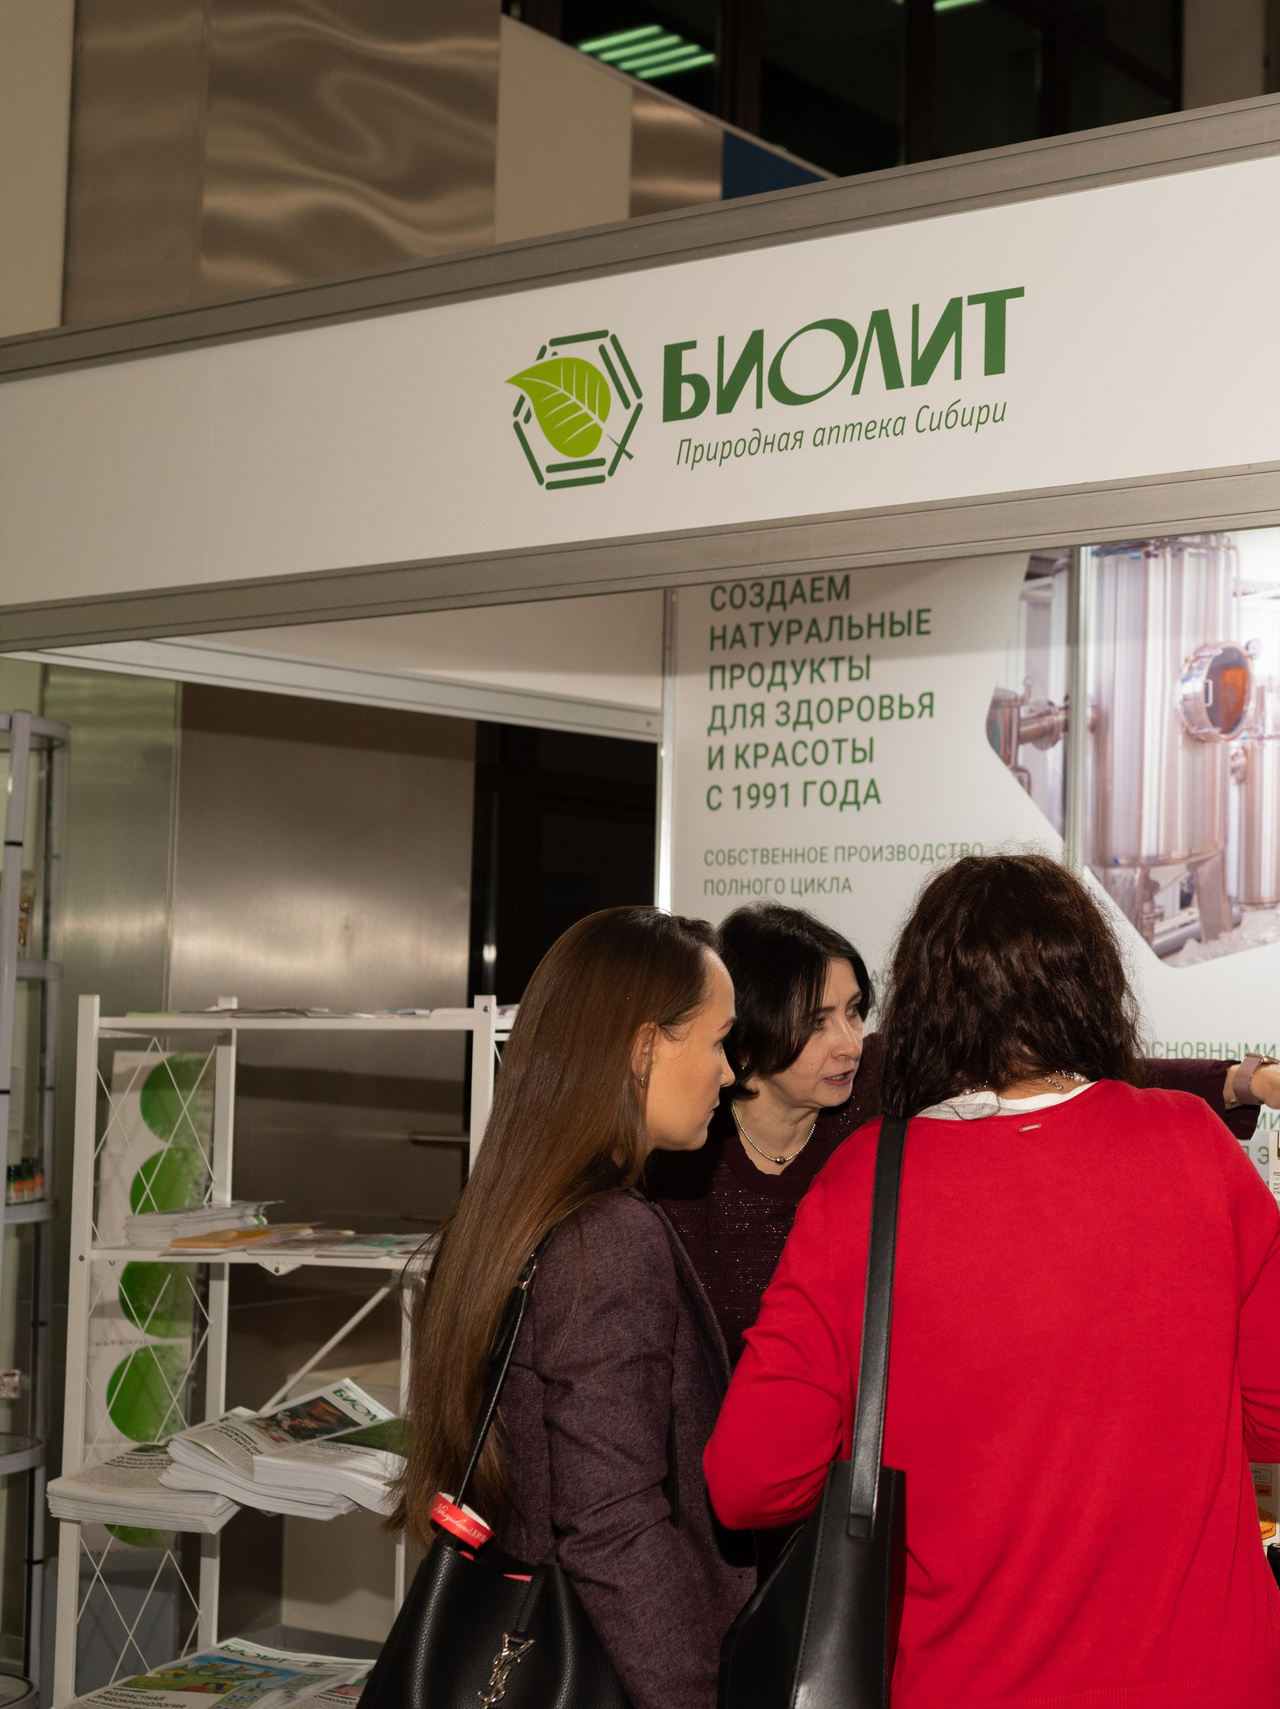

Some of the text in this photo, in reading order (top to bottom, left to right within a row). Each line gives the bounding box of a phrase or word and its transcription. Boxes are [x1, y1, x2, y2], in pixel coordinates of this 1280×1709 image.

[662, 286, 1025, 423] БИОЛИТ
[676, 399, 1007, 471] Природная аптека Сибири
[710, 575, 851, 613] СОЗДАЕМ
[709, 609, 932, 651] НАТУРАЛЬНЫЕ
[709, 655, 871, 693] ПРОДУКТЫ
[707, 692, 934, 737] ДЛЯ ЗДОРОВЬЯ
[707, 737, 874, 771] И КРАСОТЫ
[706, 778, 882, 812] С 1991 ГОДА
[704, 842, 985, 867] СОБСТВЕННОЕ ПРОИЗВОДСТВО
[704, 876, 853, 897] ПОЛНОГО ЦИКЛА
